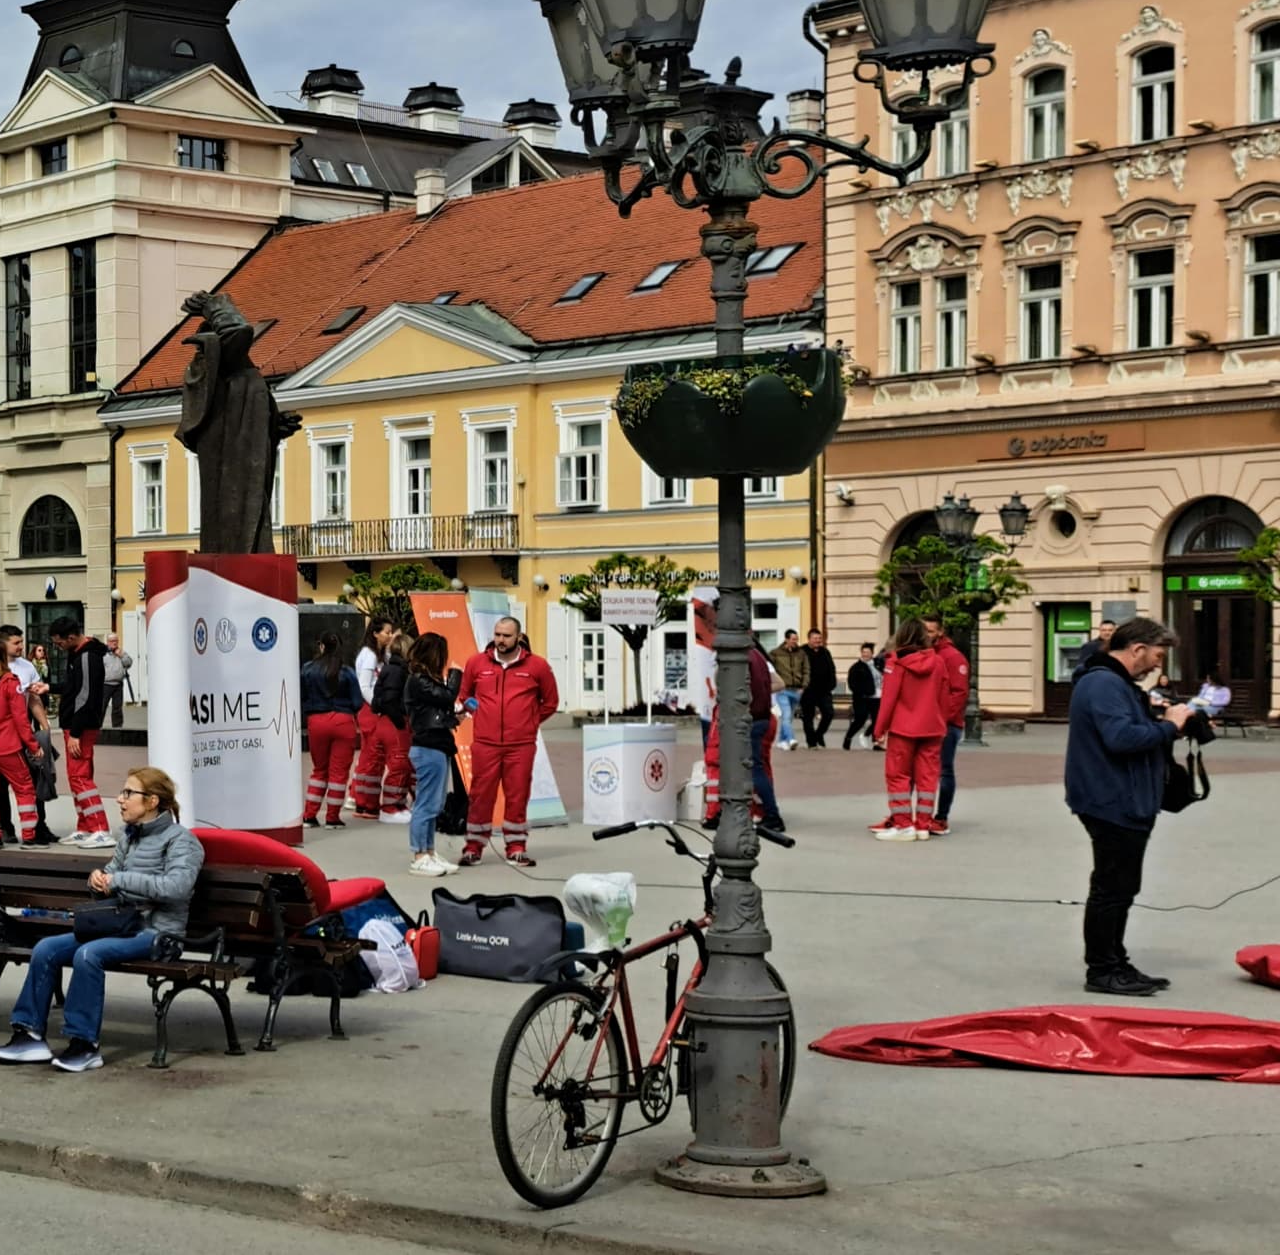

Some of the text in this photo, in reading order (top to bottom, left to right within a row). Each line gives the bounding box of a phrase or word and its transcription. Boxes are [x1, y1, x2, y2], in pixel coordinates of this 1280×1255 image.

[190, 690, 261, 725] ASI ME
[217, 738, 240, 750] ŽIVOT
